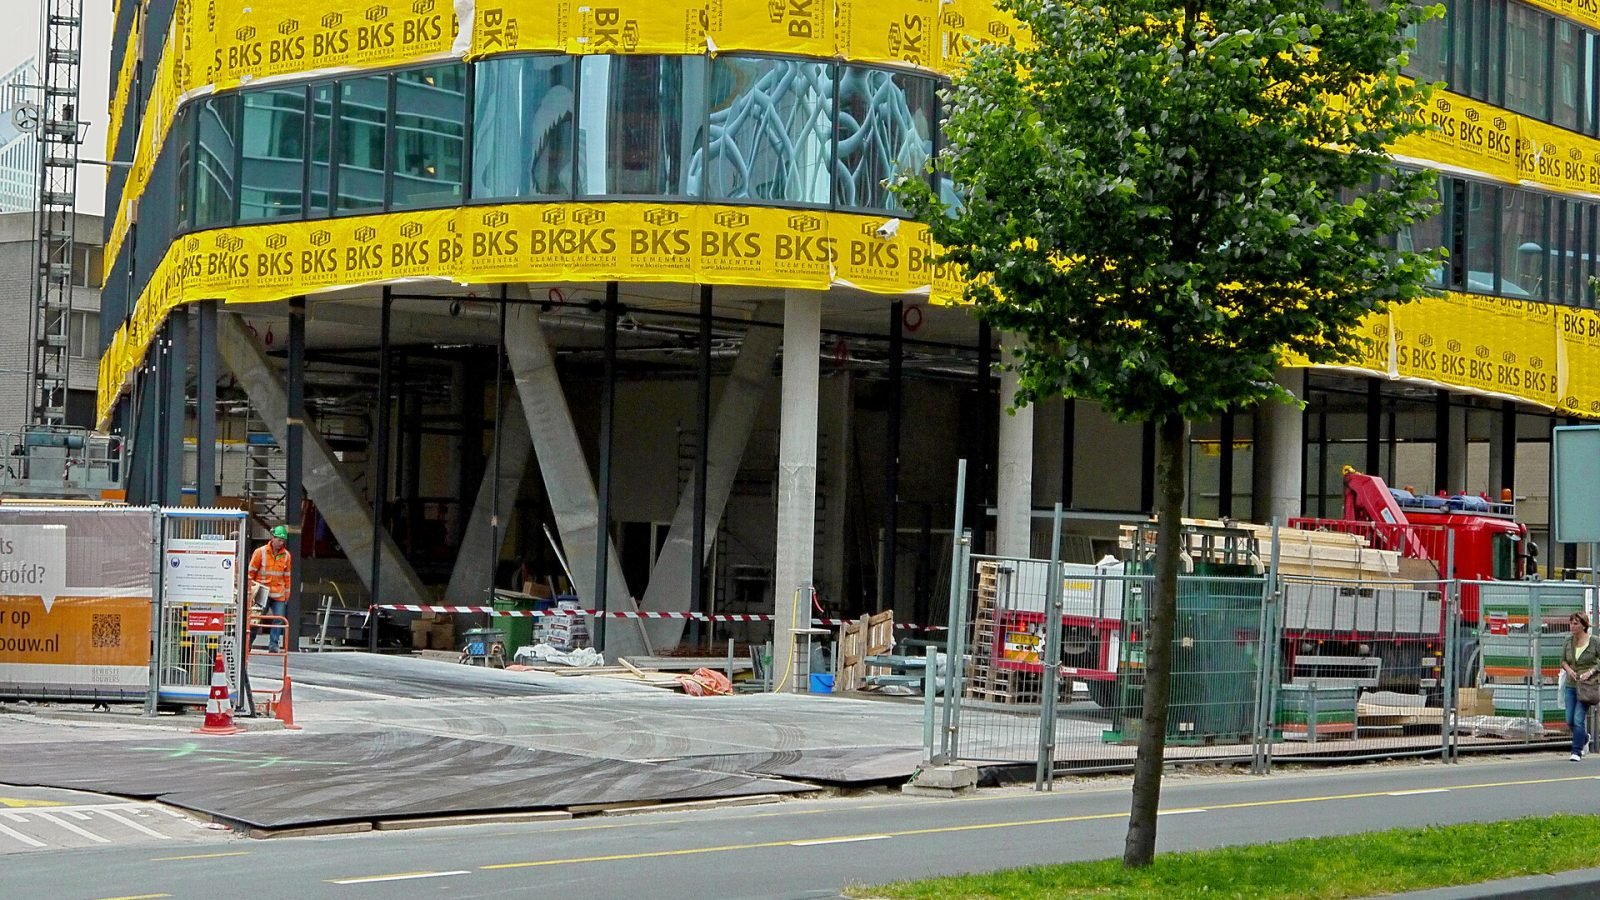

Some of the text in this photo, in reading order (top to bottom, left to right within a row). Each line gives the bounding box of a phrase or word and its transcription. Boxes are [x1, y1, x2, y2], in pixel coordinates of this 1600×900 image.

[357, 22, 395, 51] BKS
[402, 14, 441, 45] BKS
[594, 8, 619, 54] BK
[229, 42, 262, 69] BKS
[269, 36, 305, 64] BKS
[313, 29, 349, 58] BKS
[1460, 121, 1483, 146] BKS
[1488, 130, 1510, 155] BKS
[1540, 156, 1561, 178] BKS
[1565, 161, 1586, 183] BKS
[391, 239, 429, 267] BKS
[472, 230, 519, 257] BKS
[630, 229, 691, 255] BKS
[701, 230, 761, 258] BKS
[850, 240, 899, 269] BKS
[183, 253, 202, 279] BKS
[257, 251, 293, 277] BKS
[301, 247, 337, 274] BKS
[346, 244, 383, 271] BKS
[1564, 313, 1585, 336] BKS
[1412, 348, 1436, 371] BKS
[1442, 354, 1465, 377] BKS
[1470, 359, 1493, 381] BKS
[1497, 365, 1520, 387] BKS
[1524, 370, 1546, 392] BKS
[11, 611, 31, 629] op
